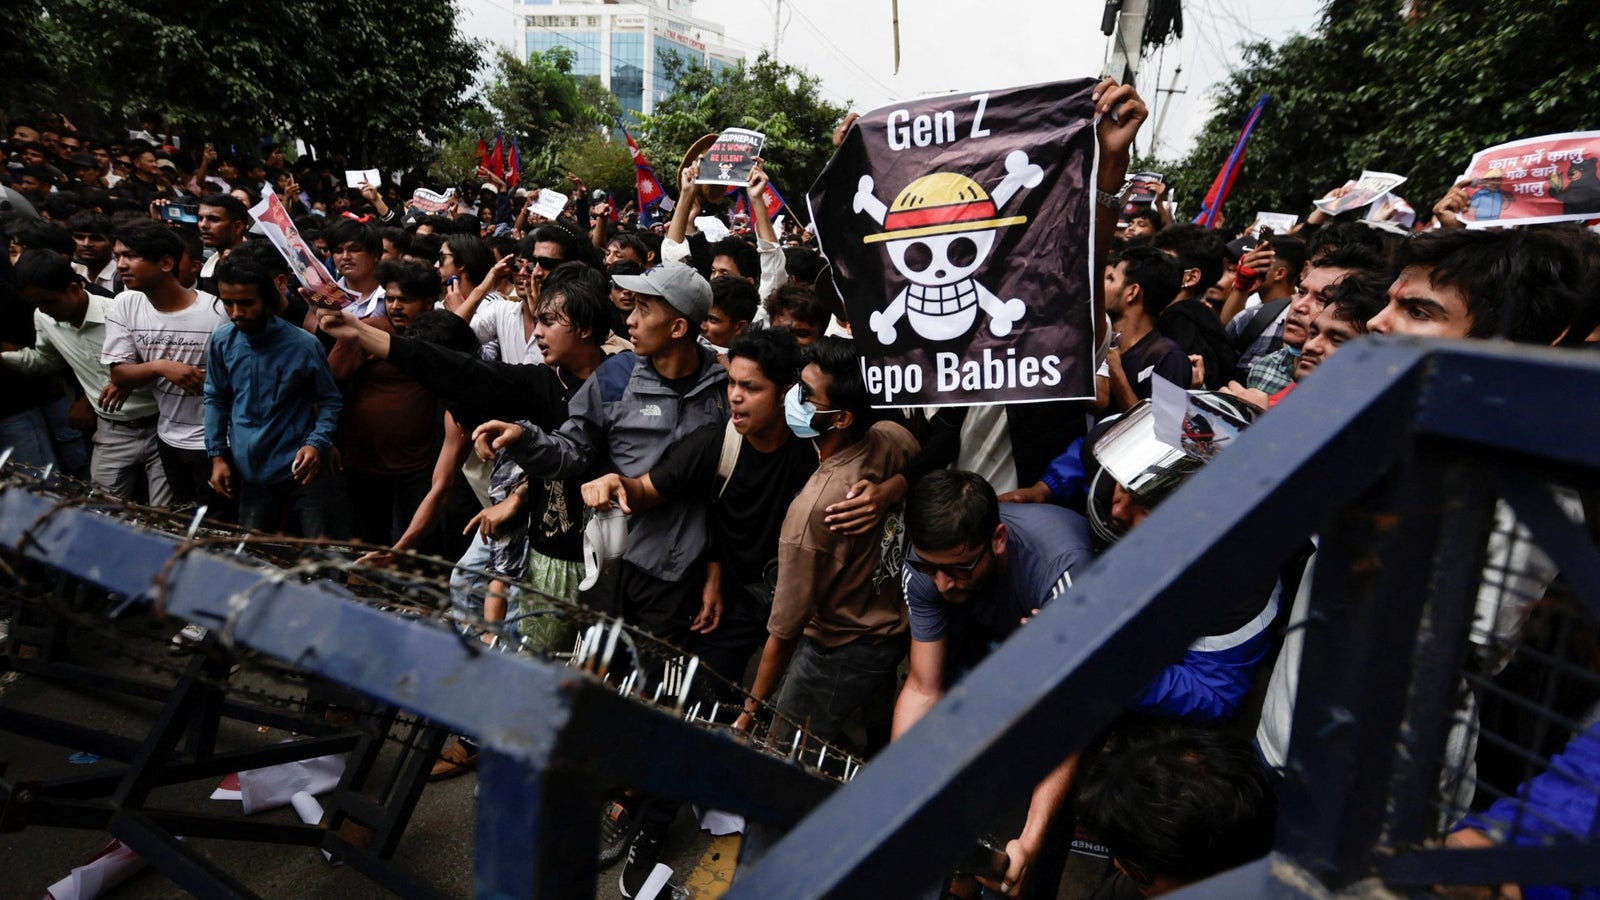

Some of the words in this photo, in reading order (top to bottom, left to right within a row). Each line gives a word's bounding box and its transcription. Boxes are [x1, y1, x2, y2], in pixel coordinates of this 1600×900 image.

[666, 29, 676, 38] THE
[677, 34, 689, 44] NEXT
[887, 108, 956, 151] Gen
[969, 92, 991, 139] Z
[721, 143, 726, 151] Z
[710, 153, 720, 162] BE
[720, 154, 744, 163] SILENT
[1488, 156, 1520, 170] काम
[1547, 147, 1586, 164] कालु
[1531, 163, 1559, 178] खाने
[1512, 181, 1546, 198] भालु
[936, 348, 1062, 392] Babies
